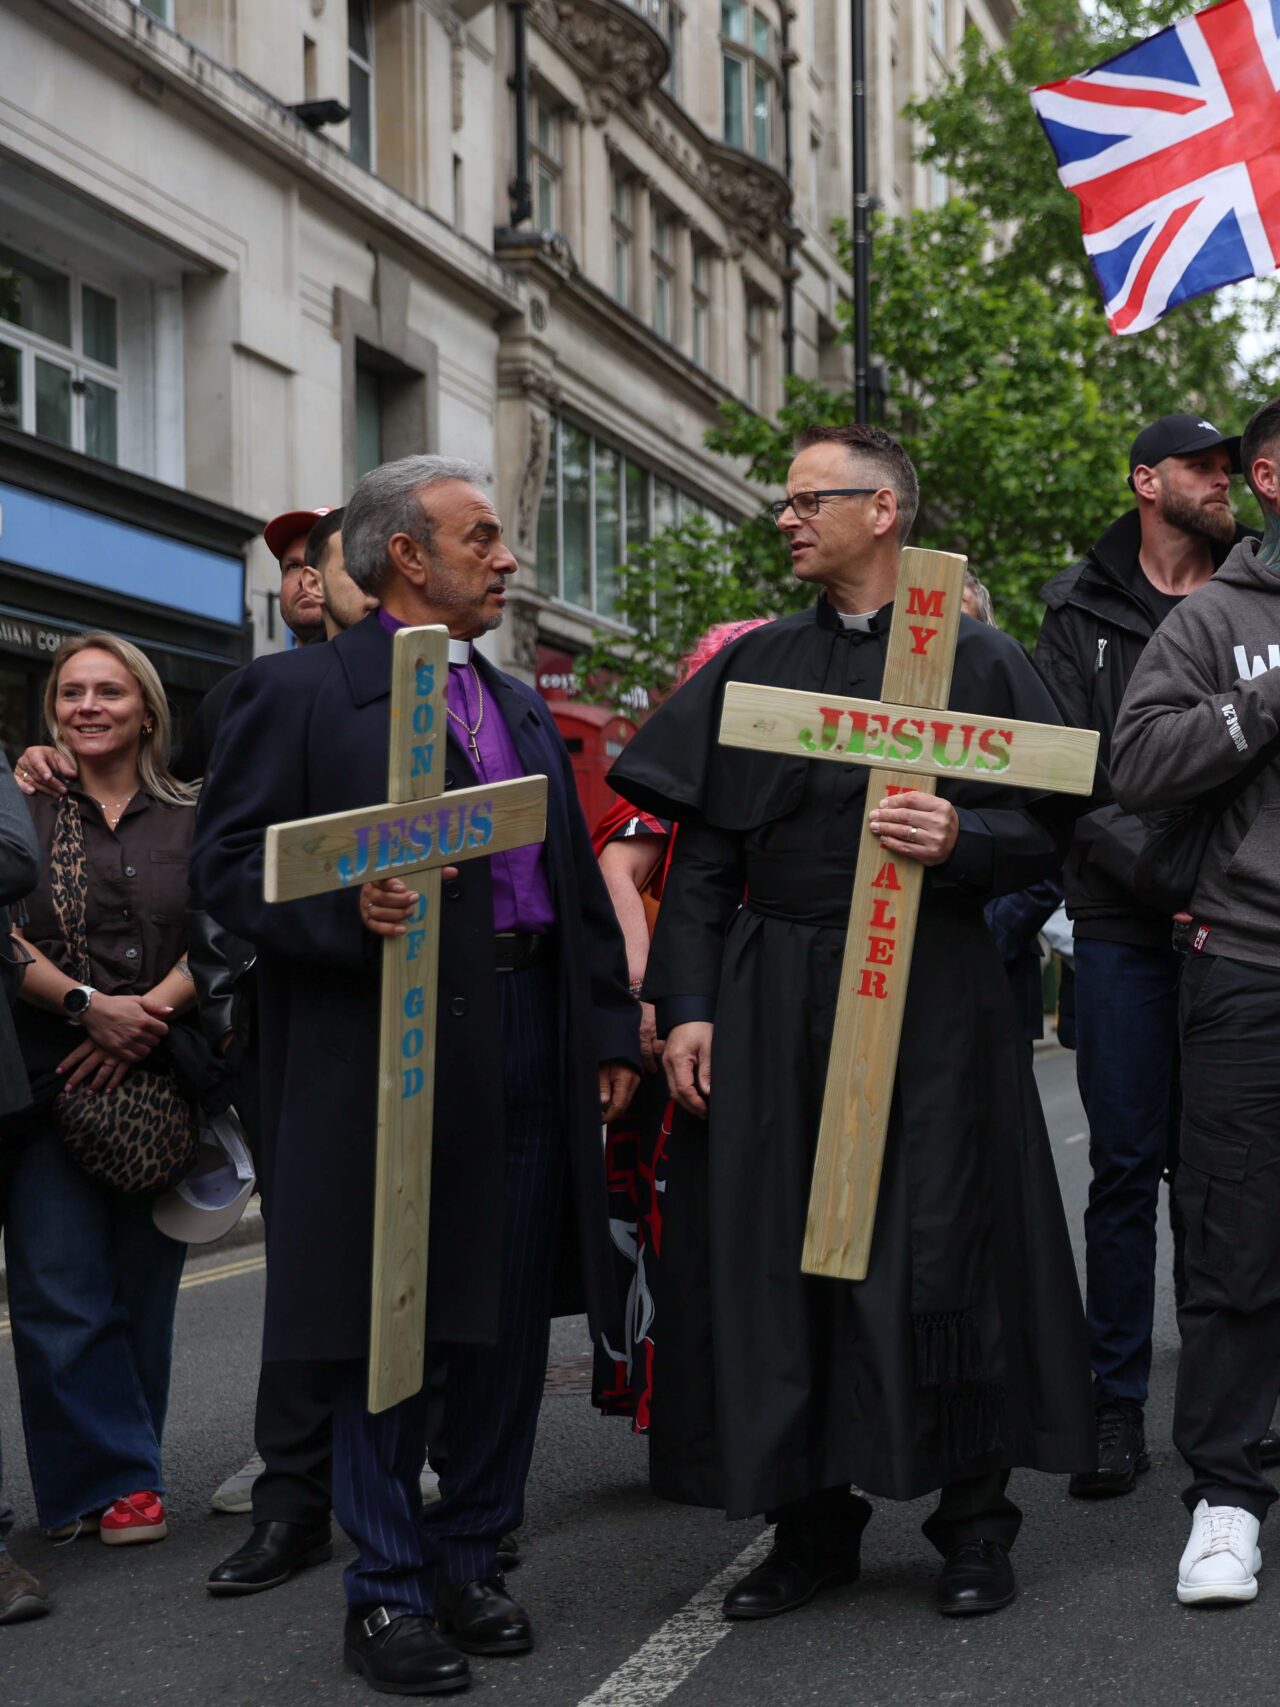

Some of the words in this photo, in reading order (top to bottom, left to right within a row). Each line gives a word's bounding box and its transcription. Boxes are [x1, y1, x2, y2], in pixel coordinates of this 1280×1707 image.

[905, 587, 946, 655] MY
[410, 664, 435, 778] SON
[798, 707, 1013, 774] JESUS
[336, 800, 493, 885] JESUS
[402, 985, 425, 1100] GOD
